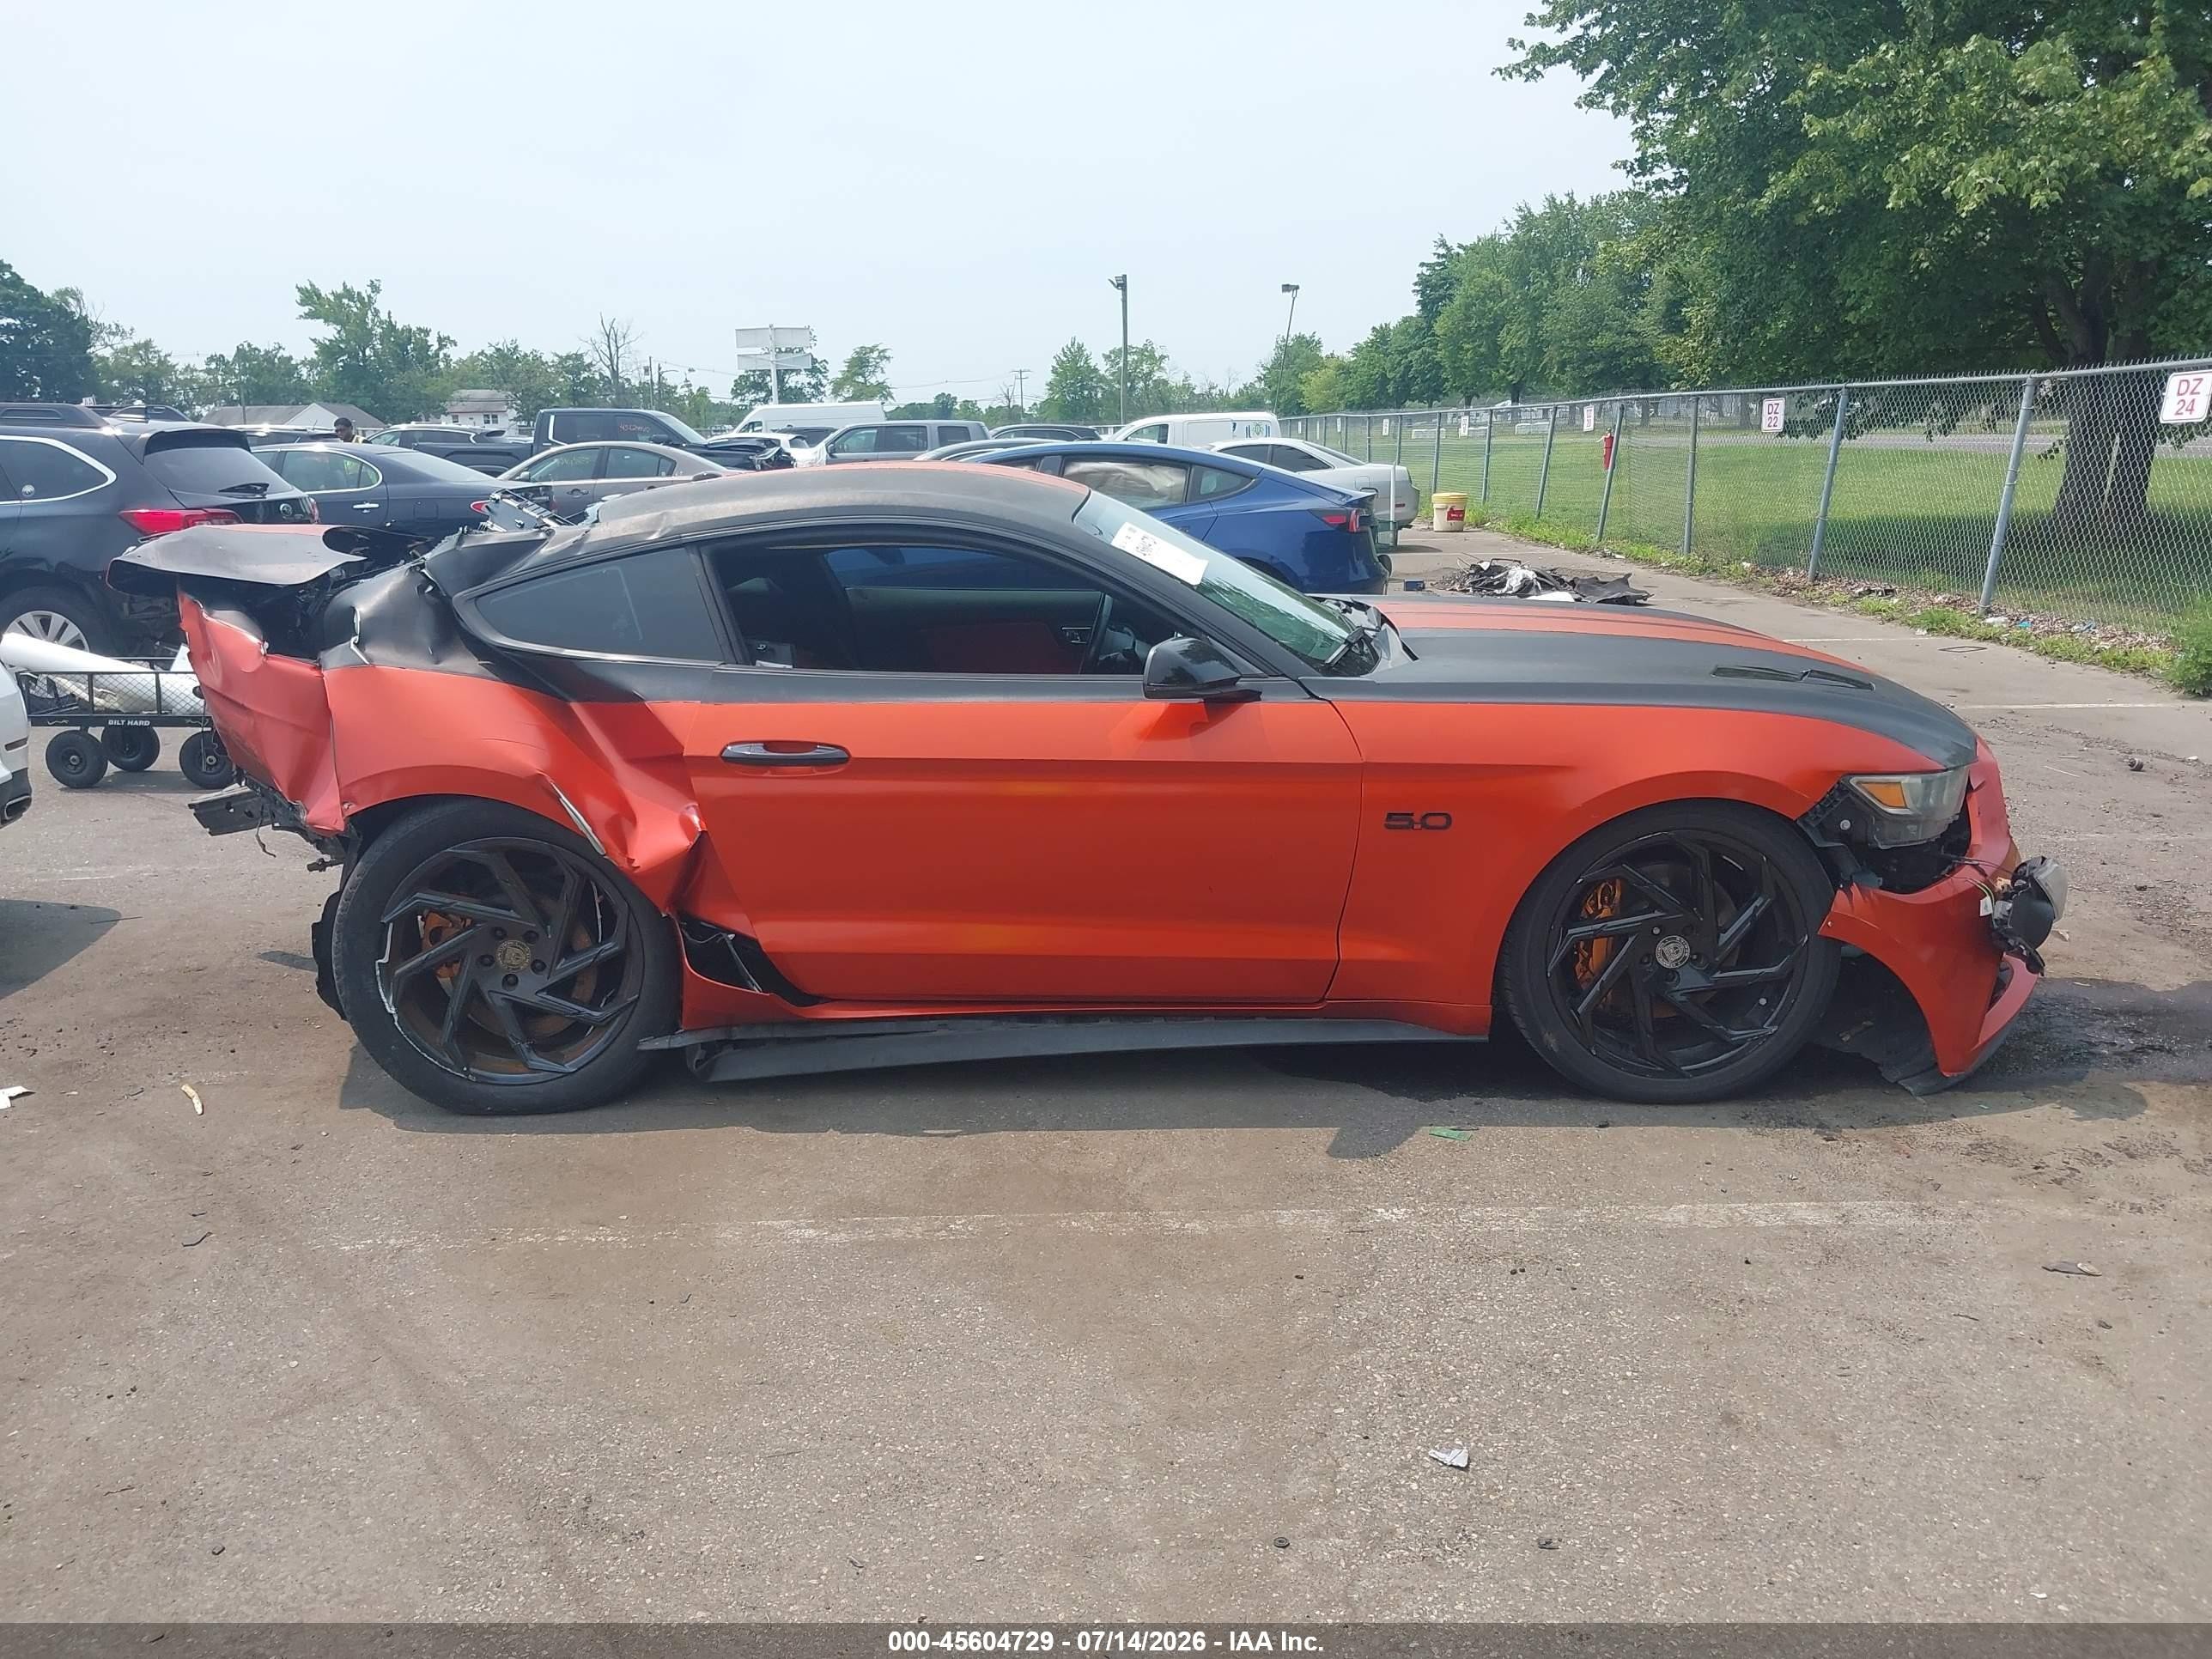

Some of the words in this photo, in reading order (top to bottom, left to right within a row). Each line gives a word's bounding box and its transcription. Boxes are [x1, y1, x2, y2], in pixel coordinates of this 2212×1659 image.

[2177, 378, 2203, 396] DZ
[1767, 404, 1780, 415] DZ
[2174, 398, 2196, 416] 24
[1767, 416, 1778, 428] 22
[1384, 811, 1452, 831] 5.0
